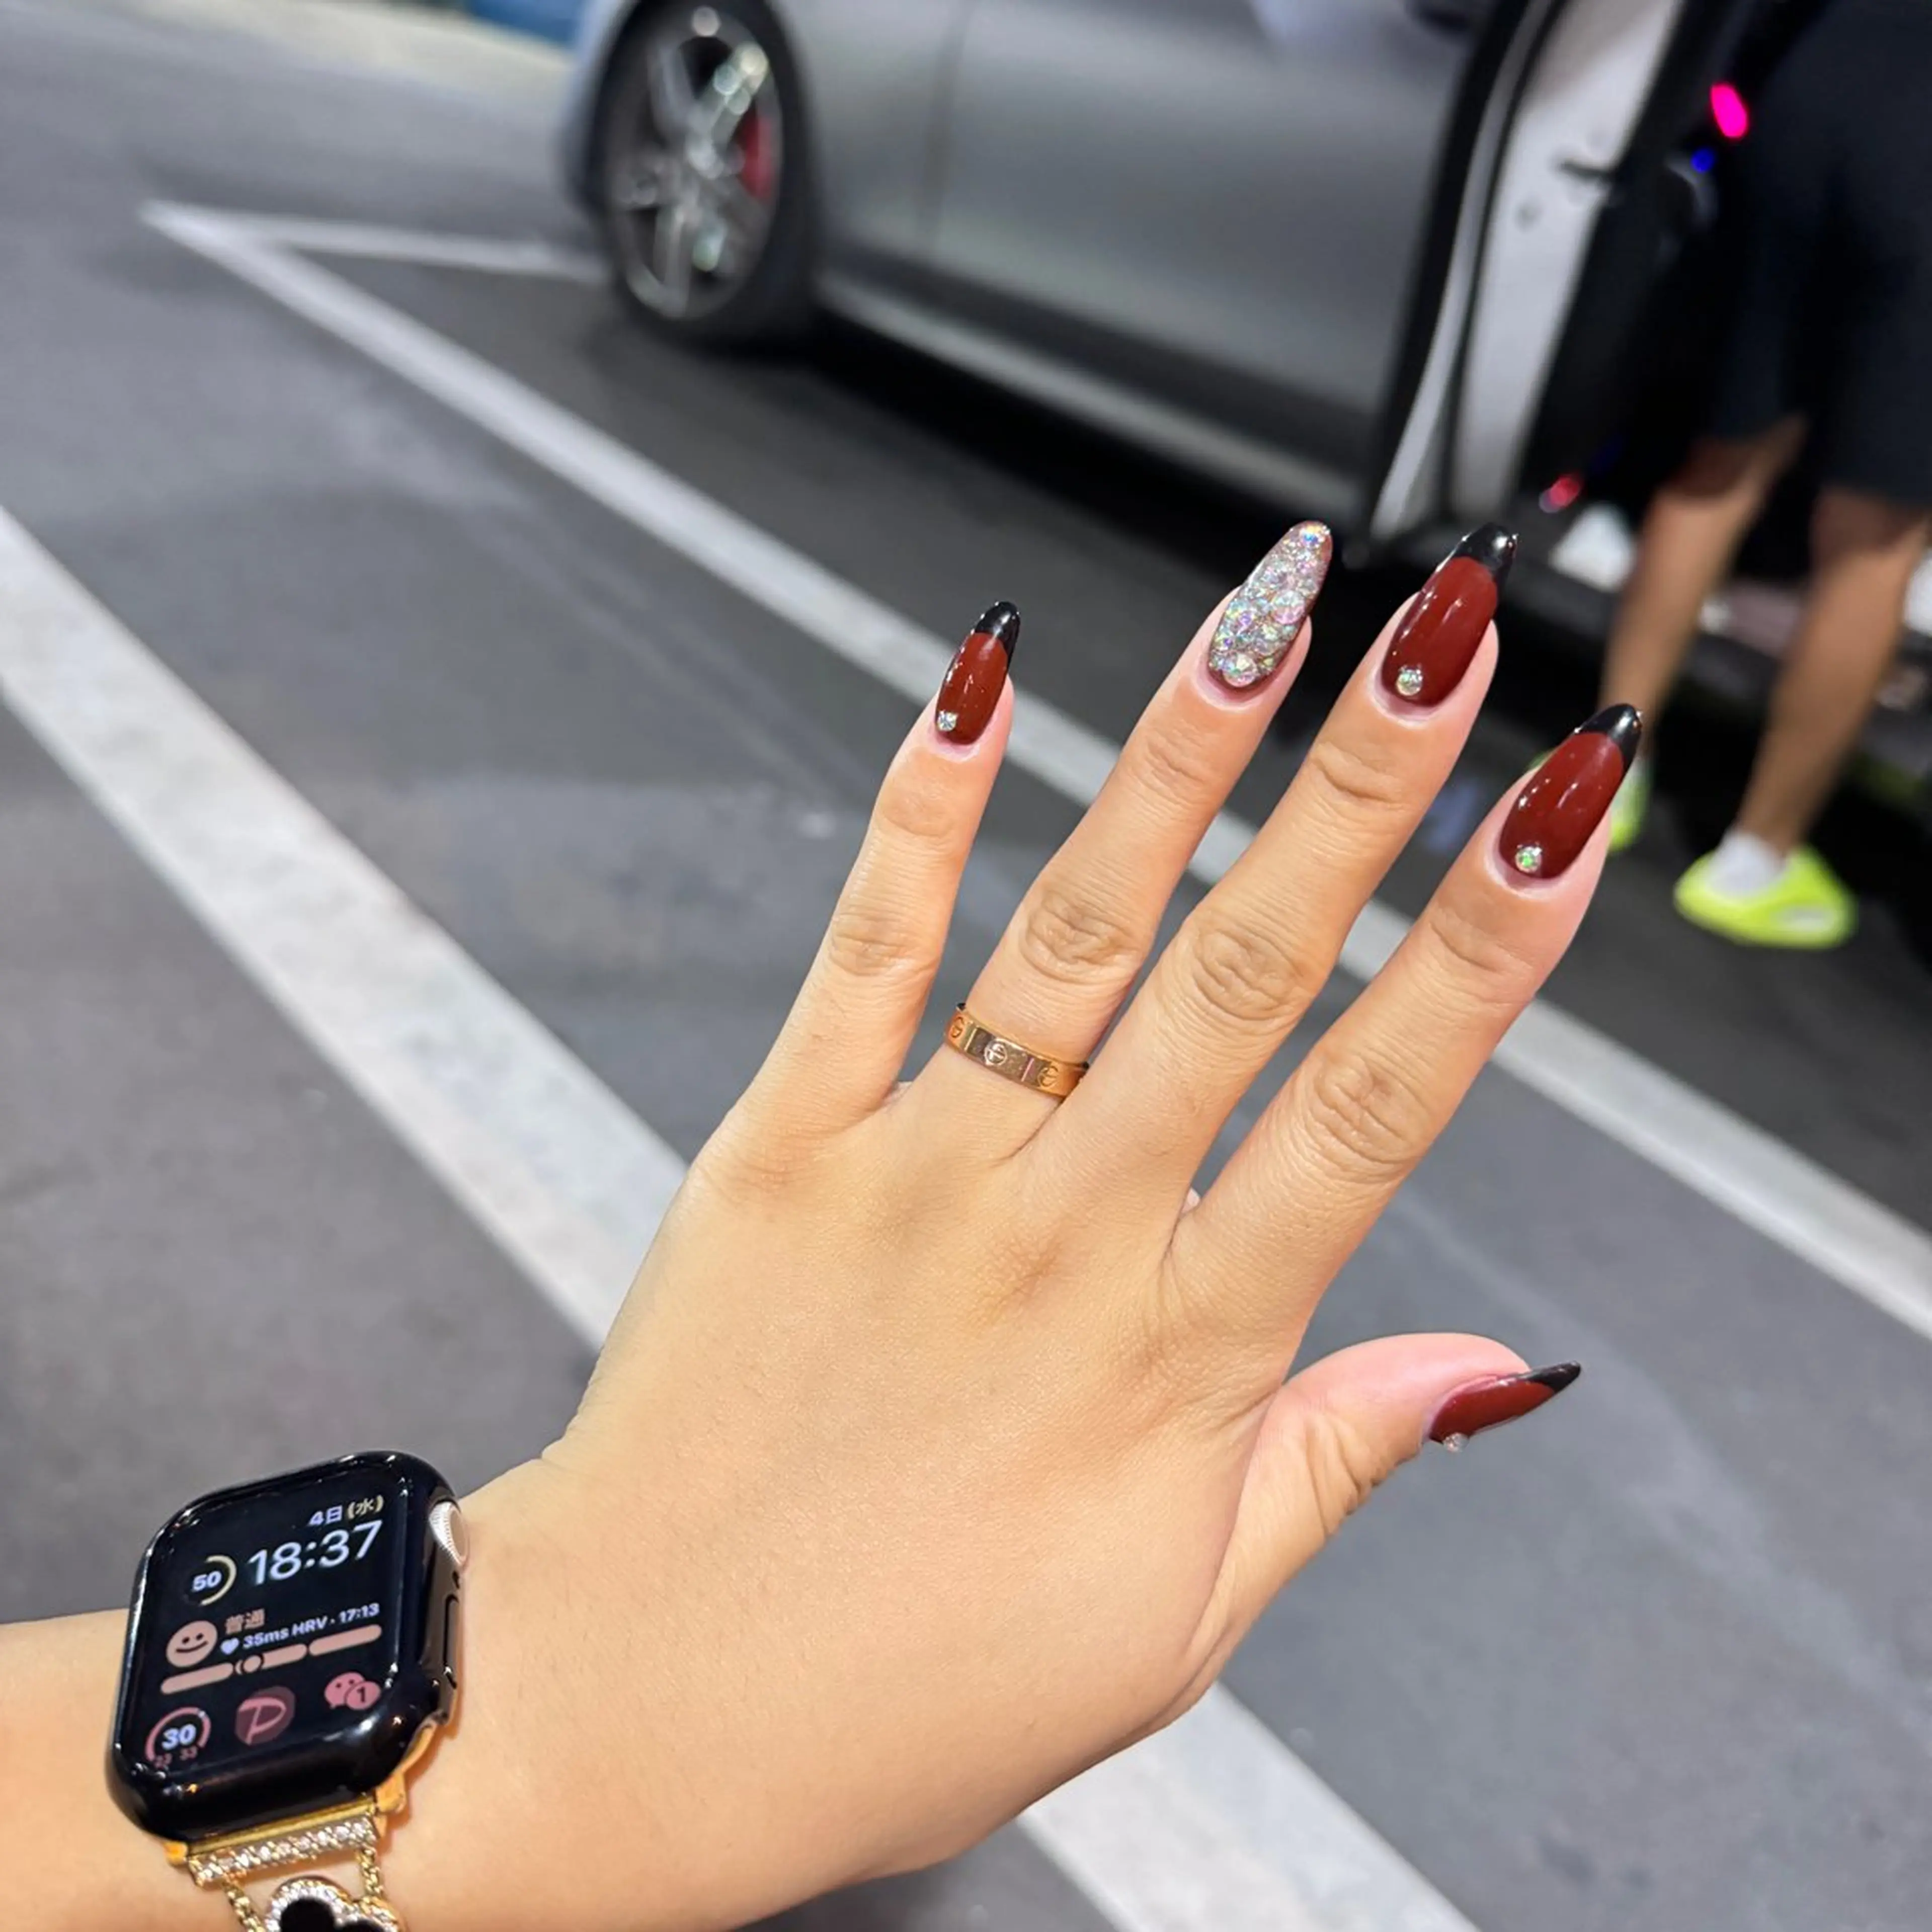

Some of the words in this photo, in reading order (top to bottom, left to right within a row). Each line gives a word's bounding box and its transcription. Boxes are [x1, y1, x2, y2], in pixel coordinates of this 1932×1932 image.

[248, 1519, 382, 1585] 18:37
[192, 1570, 222, 1592] 50
[243, 1628, 289, 1649] 35ms
[291, 1616, 328, 1636] HRV
[339, 1603, 379, 1624] 17:13
[357, 1686, 366, 1704] 1
[161, 1724, 196, 1750] 30
